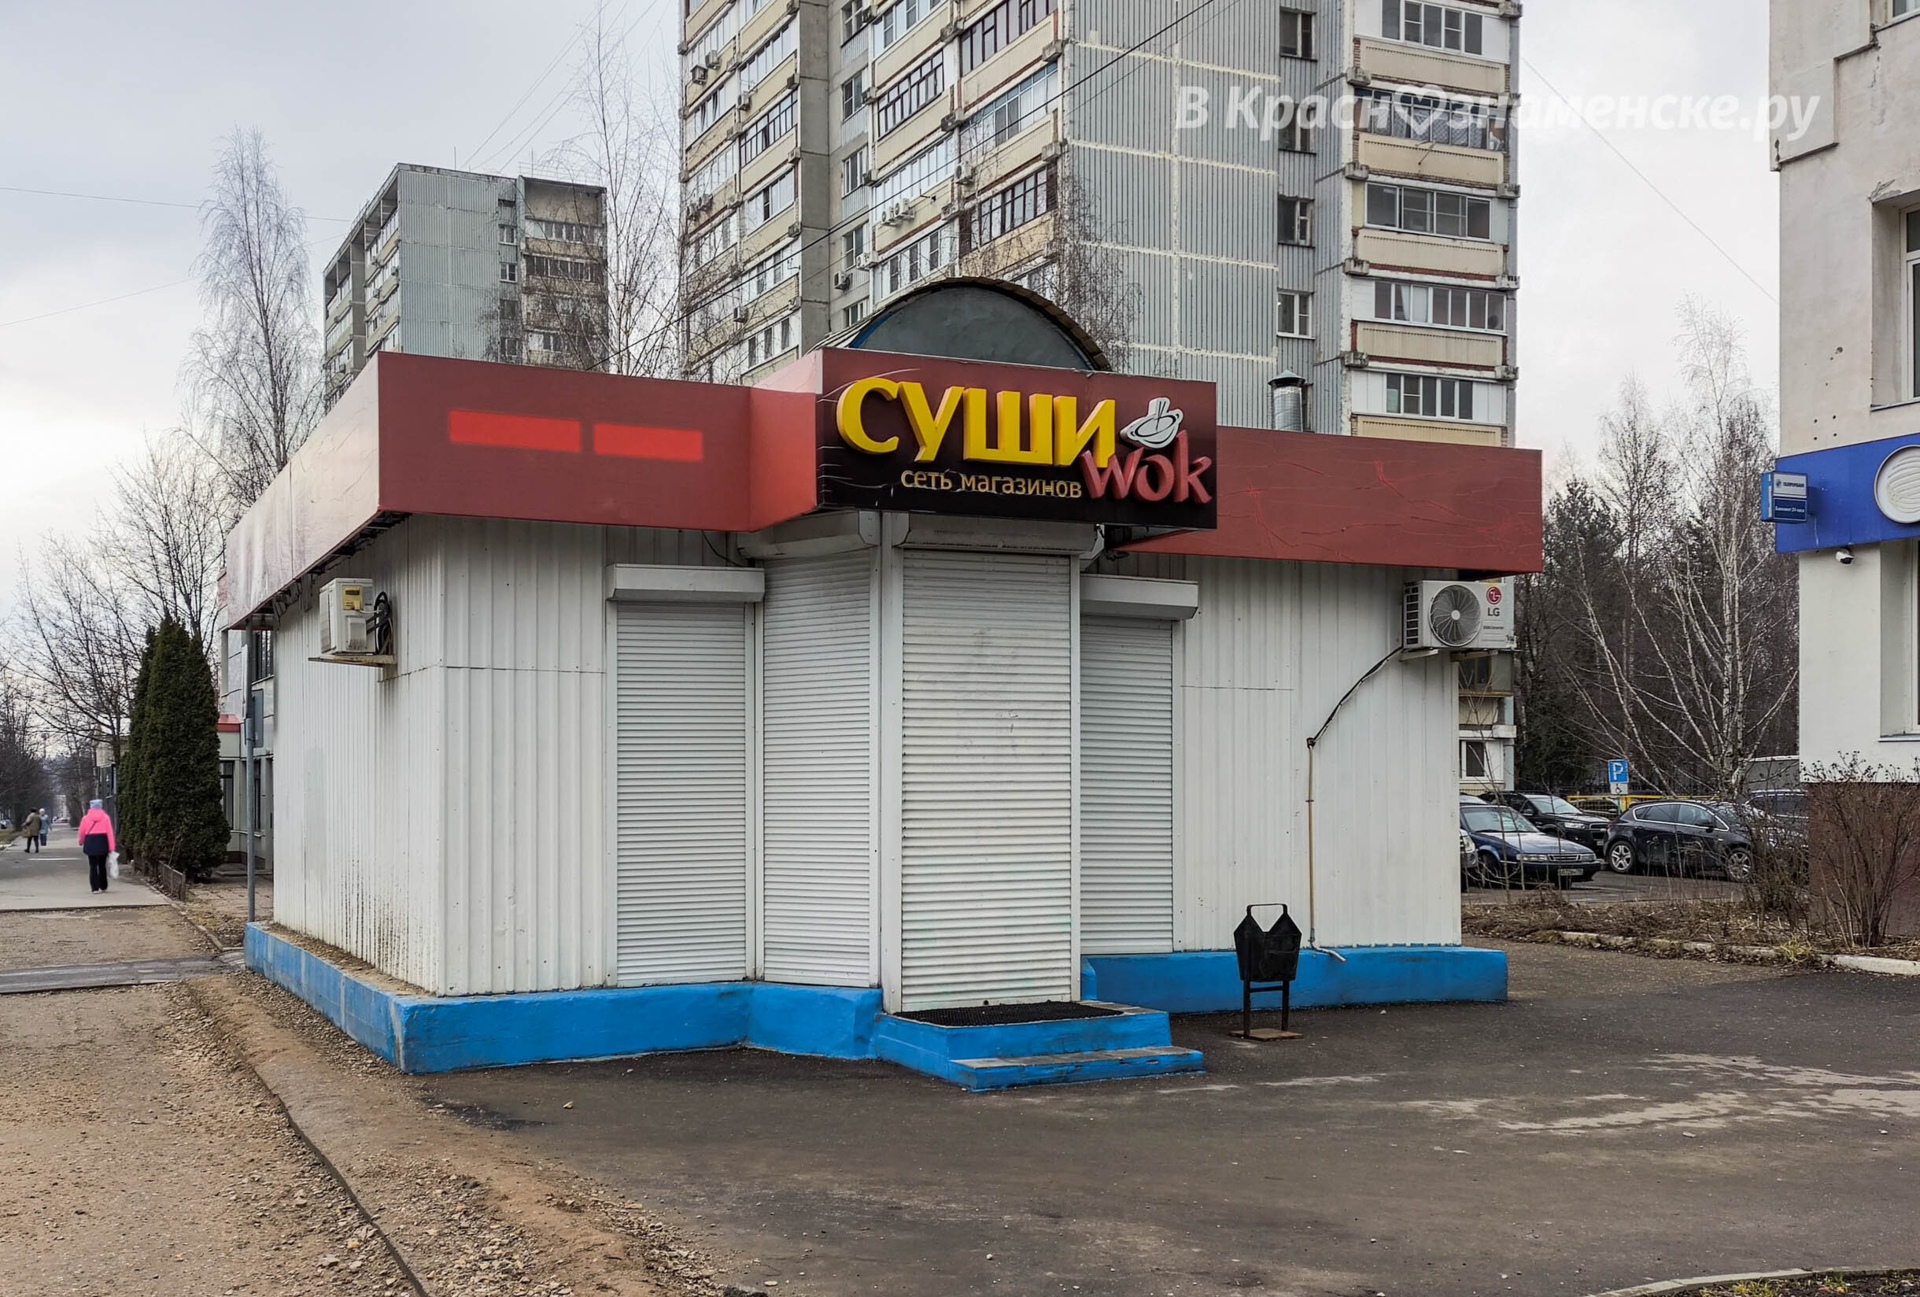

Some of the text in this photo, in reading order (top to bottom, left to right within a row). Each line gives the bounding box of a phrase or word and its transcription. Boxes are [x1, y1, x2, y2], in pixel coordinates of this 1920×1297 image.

[836, 378, 1116, 468] СУШИ
[900, 470, 1082, 499] сеть магазинов
[1487, 607, 1500, 617] LG
[1613, 762, 1624, 781] P
